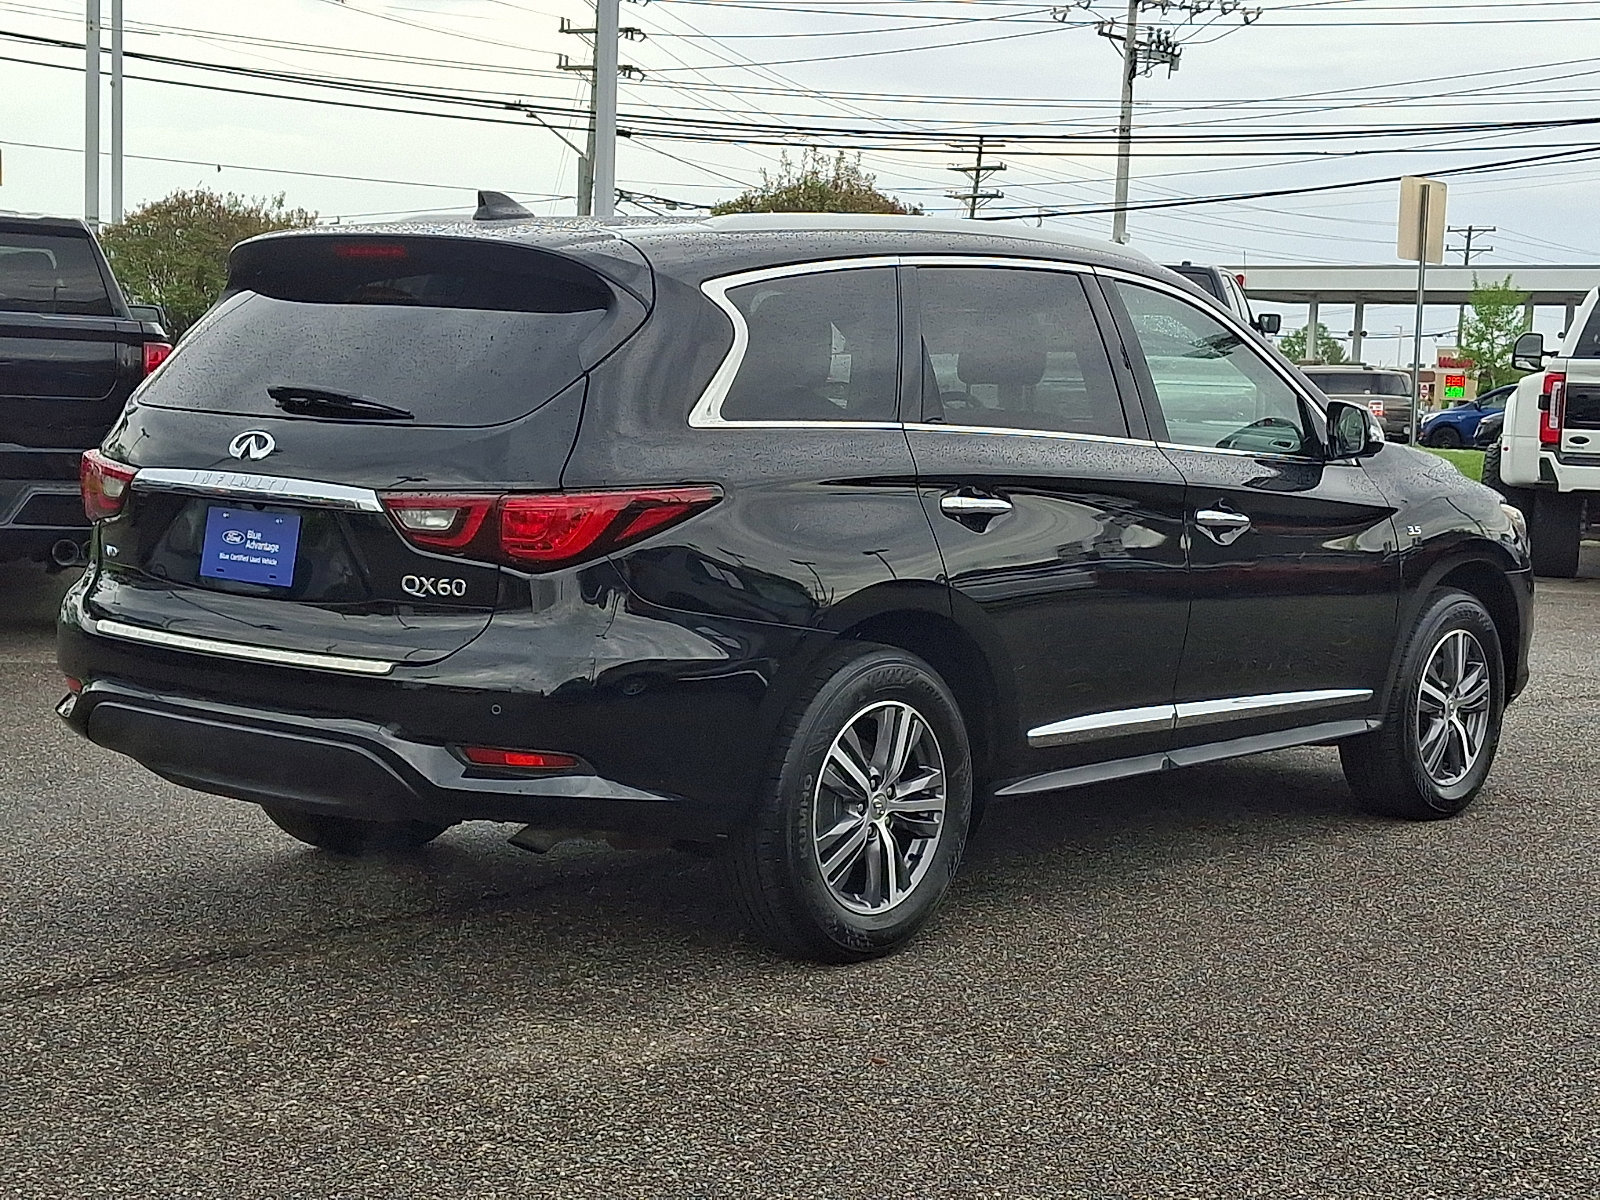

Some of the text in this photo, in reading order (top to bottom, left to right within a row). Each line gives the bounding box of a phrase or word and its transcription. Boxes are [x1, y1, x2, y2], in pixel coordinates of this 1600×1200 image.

[191, 472, 288, 491] INFINITI
[225, 530, 242, 543] Ford
[247, 530, 262, 540] Blue
[246, 540, 280, 553] Advantage
[219, 552, 278, 566] Blue Certified Used Vehicle
[401, 575, 467, 598] QX60
[799, 774, 812, 859] KUMHO
